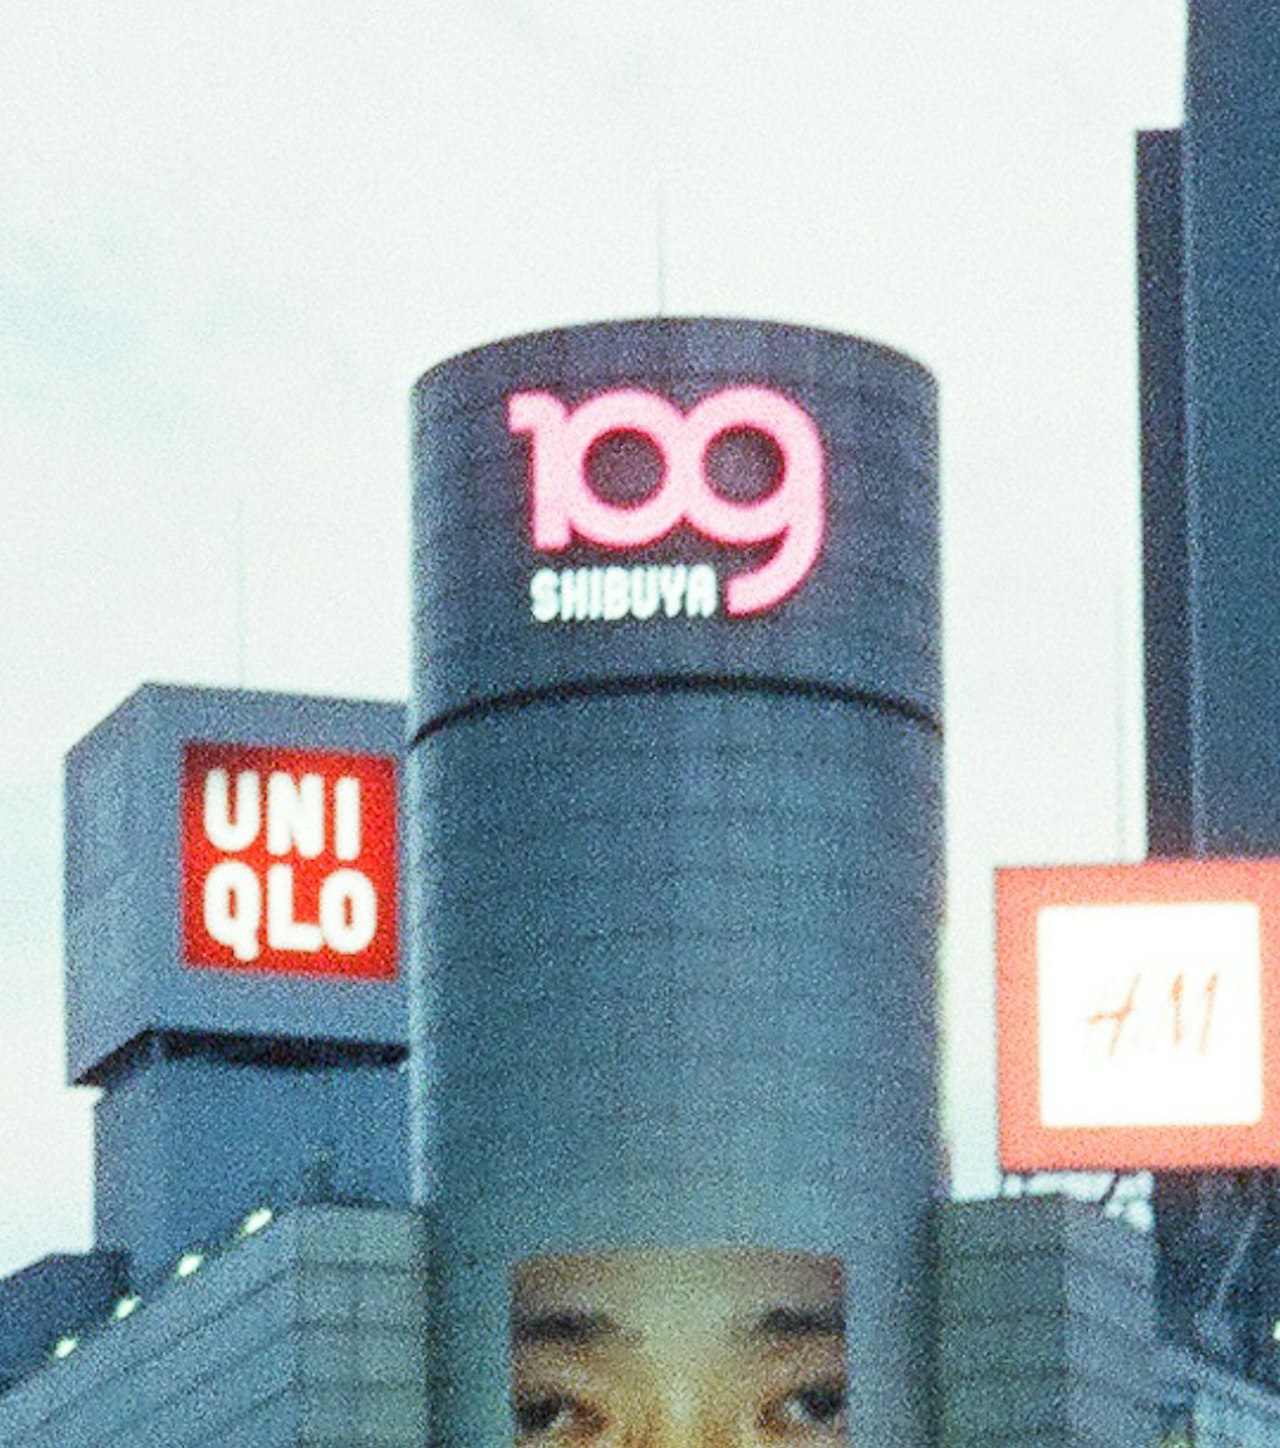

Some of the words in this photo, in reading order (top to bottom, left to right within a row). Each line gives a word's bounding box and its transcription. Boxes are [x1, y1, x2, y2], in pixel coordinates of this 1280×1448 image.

[507, 386, 827, 616] 109
[530, 565, 718, 622] SHIBUYA
[203, 768, 362, 860] UNI
[202, 862, 379, 961] QLO
